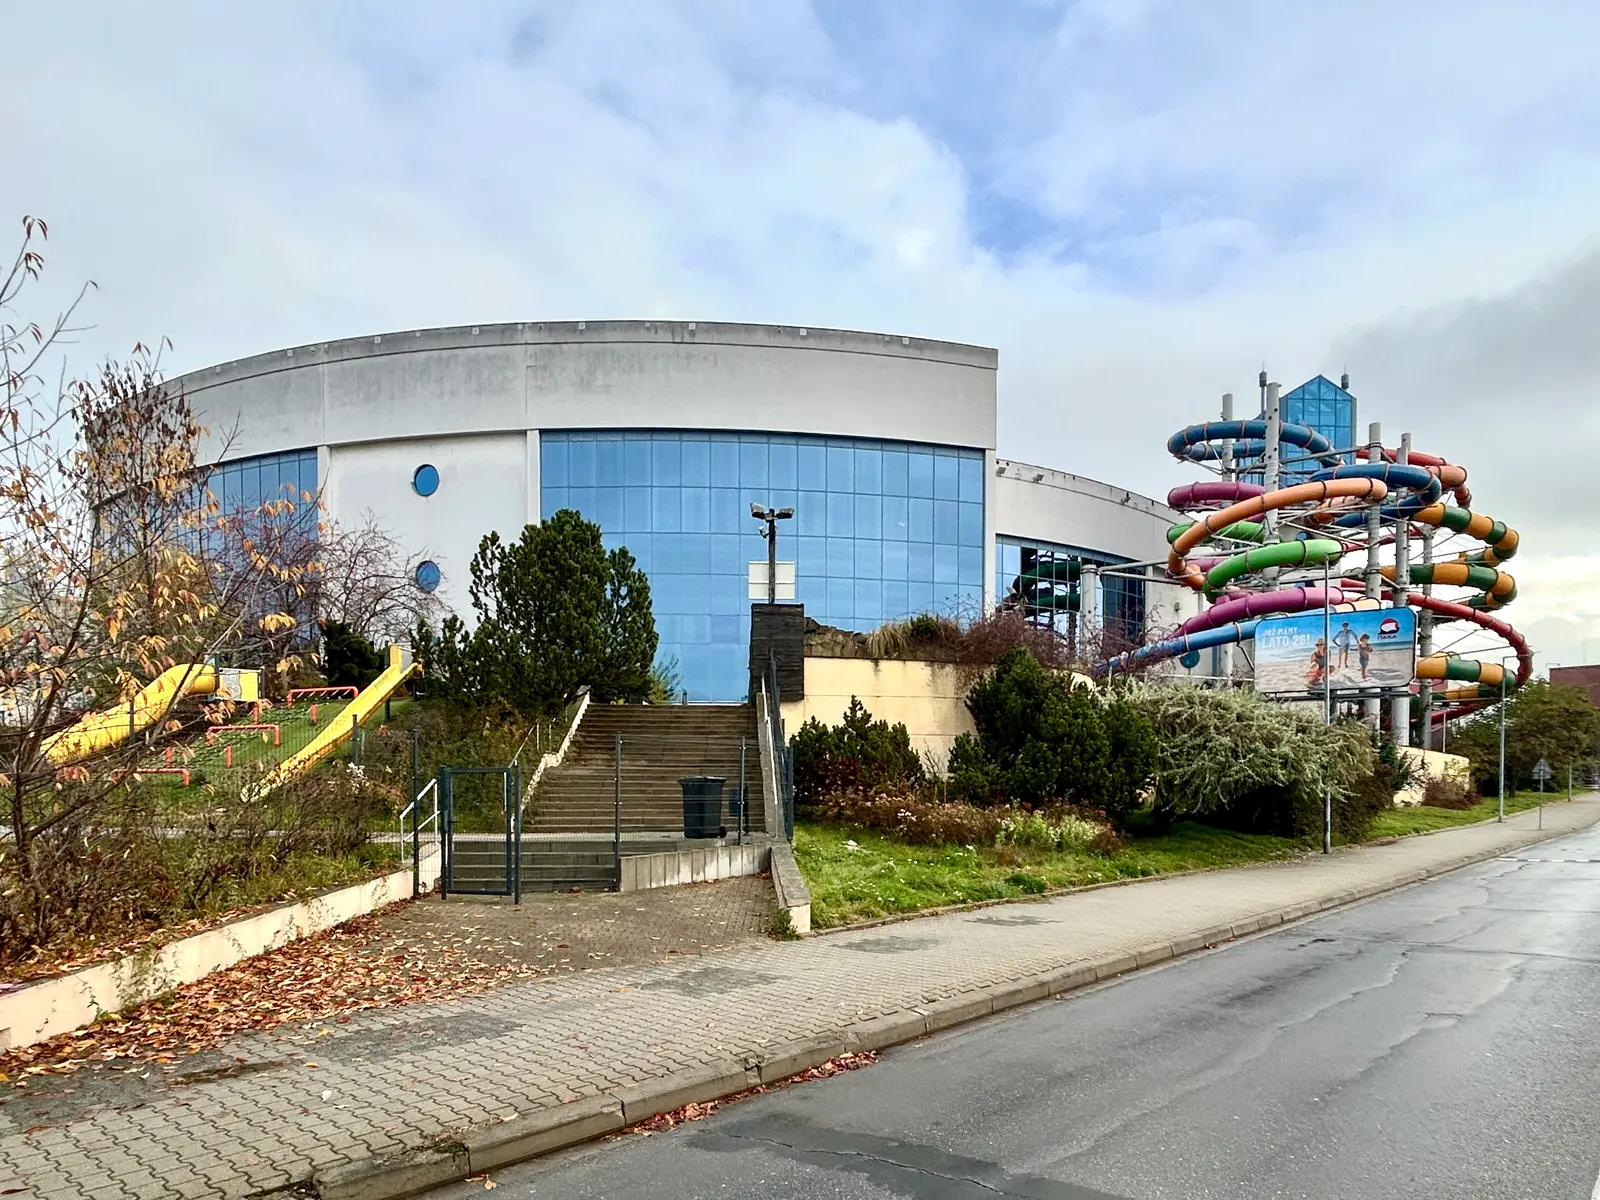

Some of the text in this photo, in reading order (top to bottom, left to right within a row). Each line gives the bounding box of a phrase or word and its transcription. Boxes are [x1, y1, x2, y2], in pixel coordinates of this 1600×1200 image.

[1278, 627, 1298, 635] MAMY
[1262, 633, 1311, 648] LATO 26!
